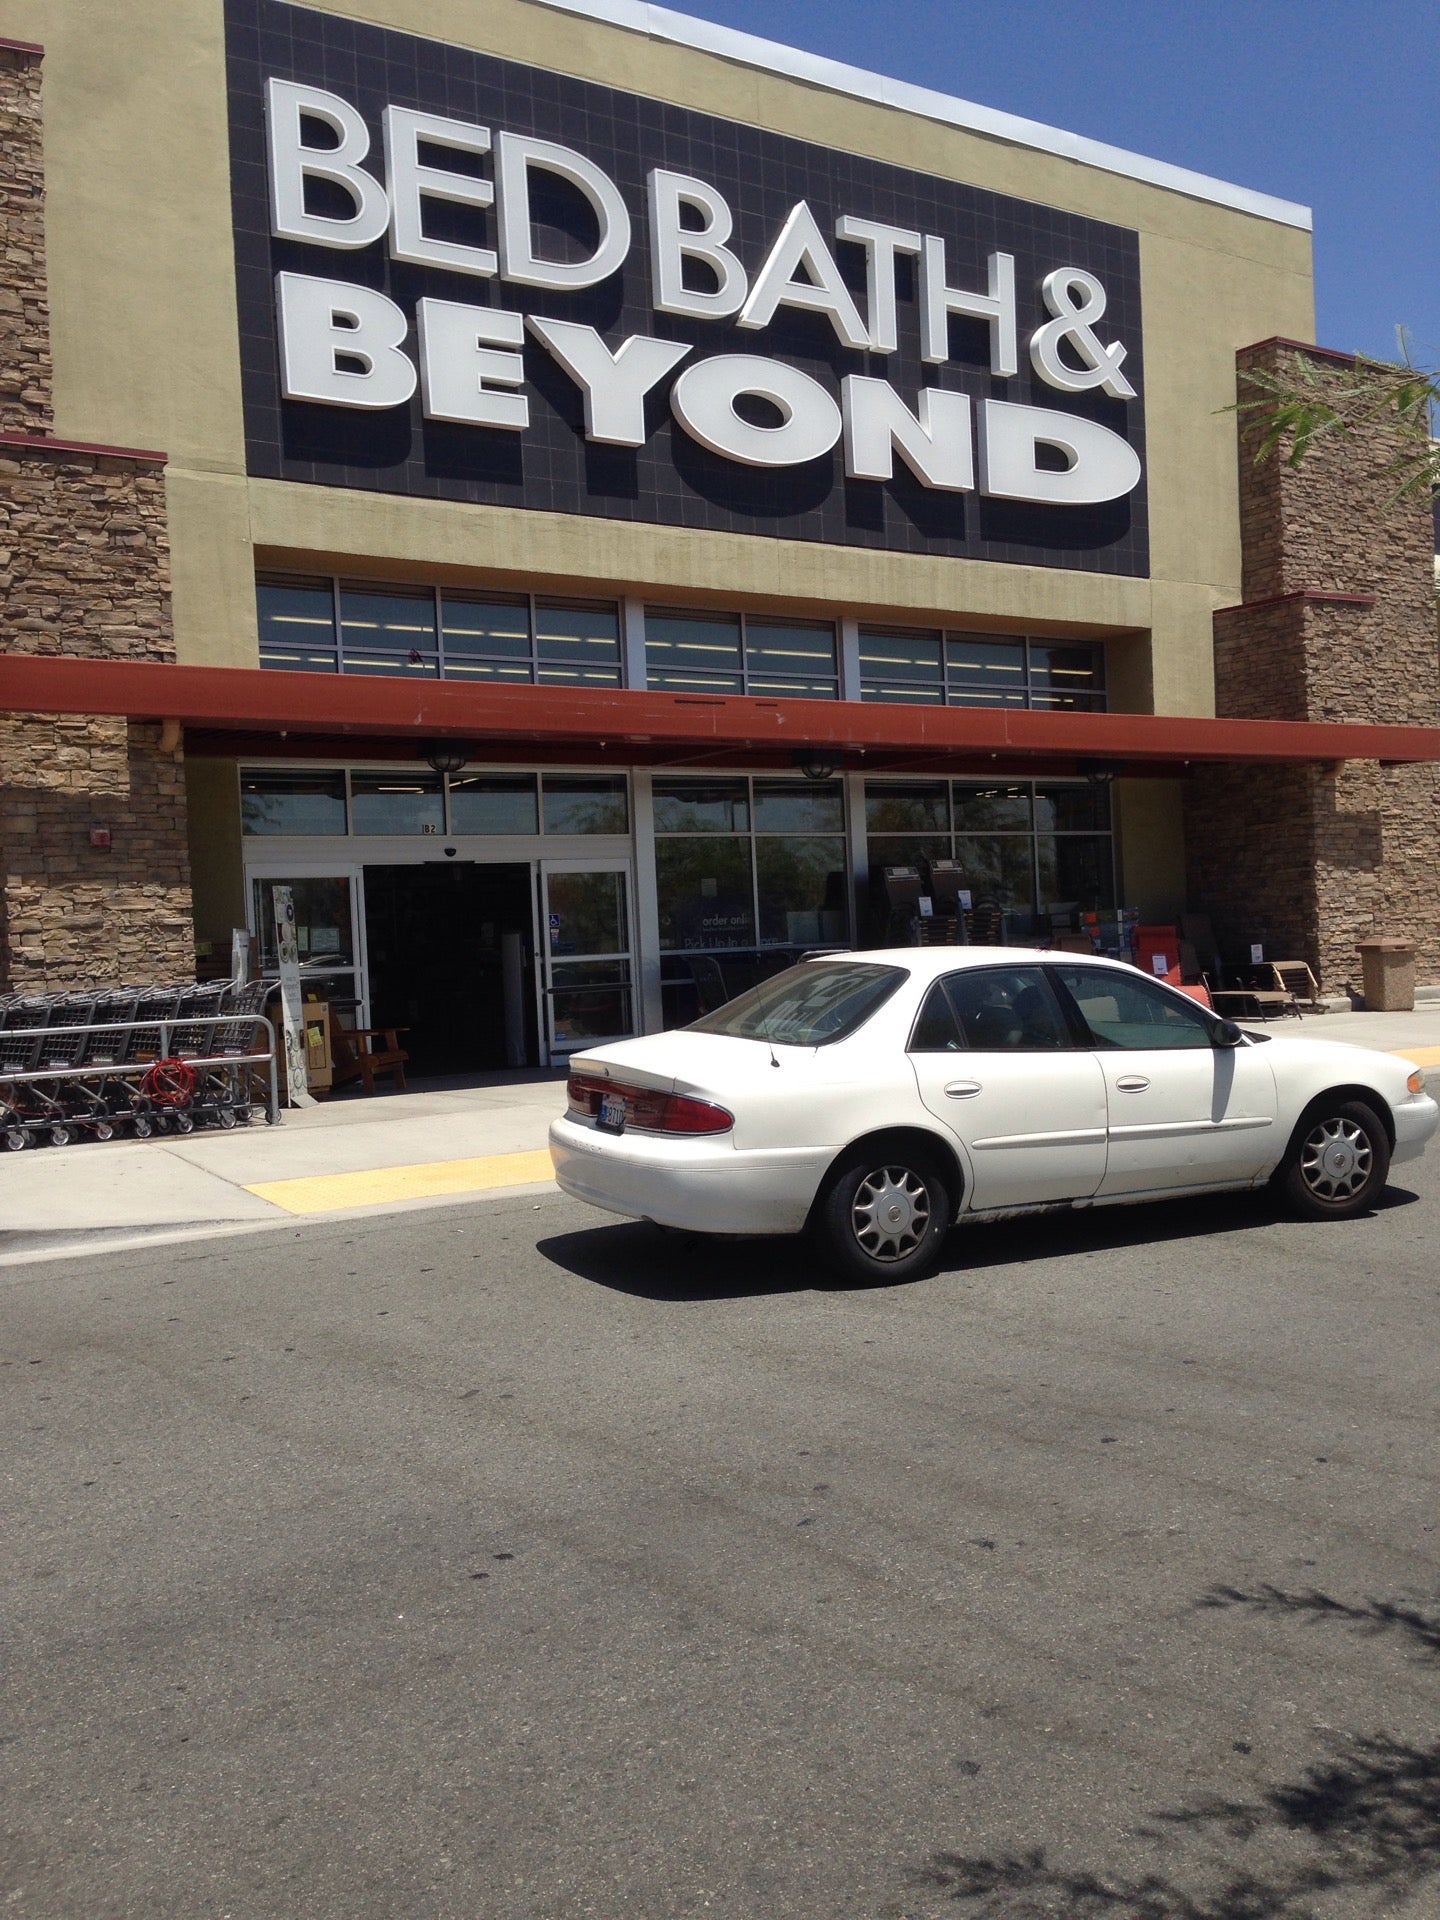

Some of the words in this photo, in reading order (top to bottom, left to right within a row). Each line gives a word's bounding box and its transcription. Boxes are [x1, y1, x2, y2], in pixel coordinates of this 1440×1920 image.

[266, 77, 631, 290] BED
[647, 168, 1018, 377] BATH
[1030, 266, 1137, 400] &
[275, 270, 1142, 506] BEYOND
[703, 914, 728, 926] order
